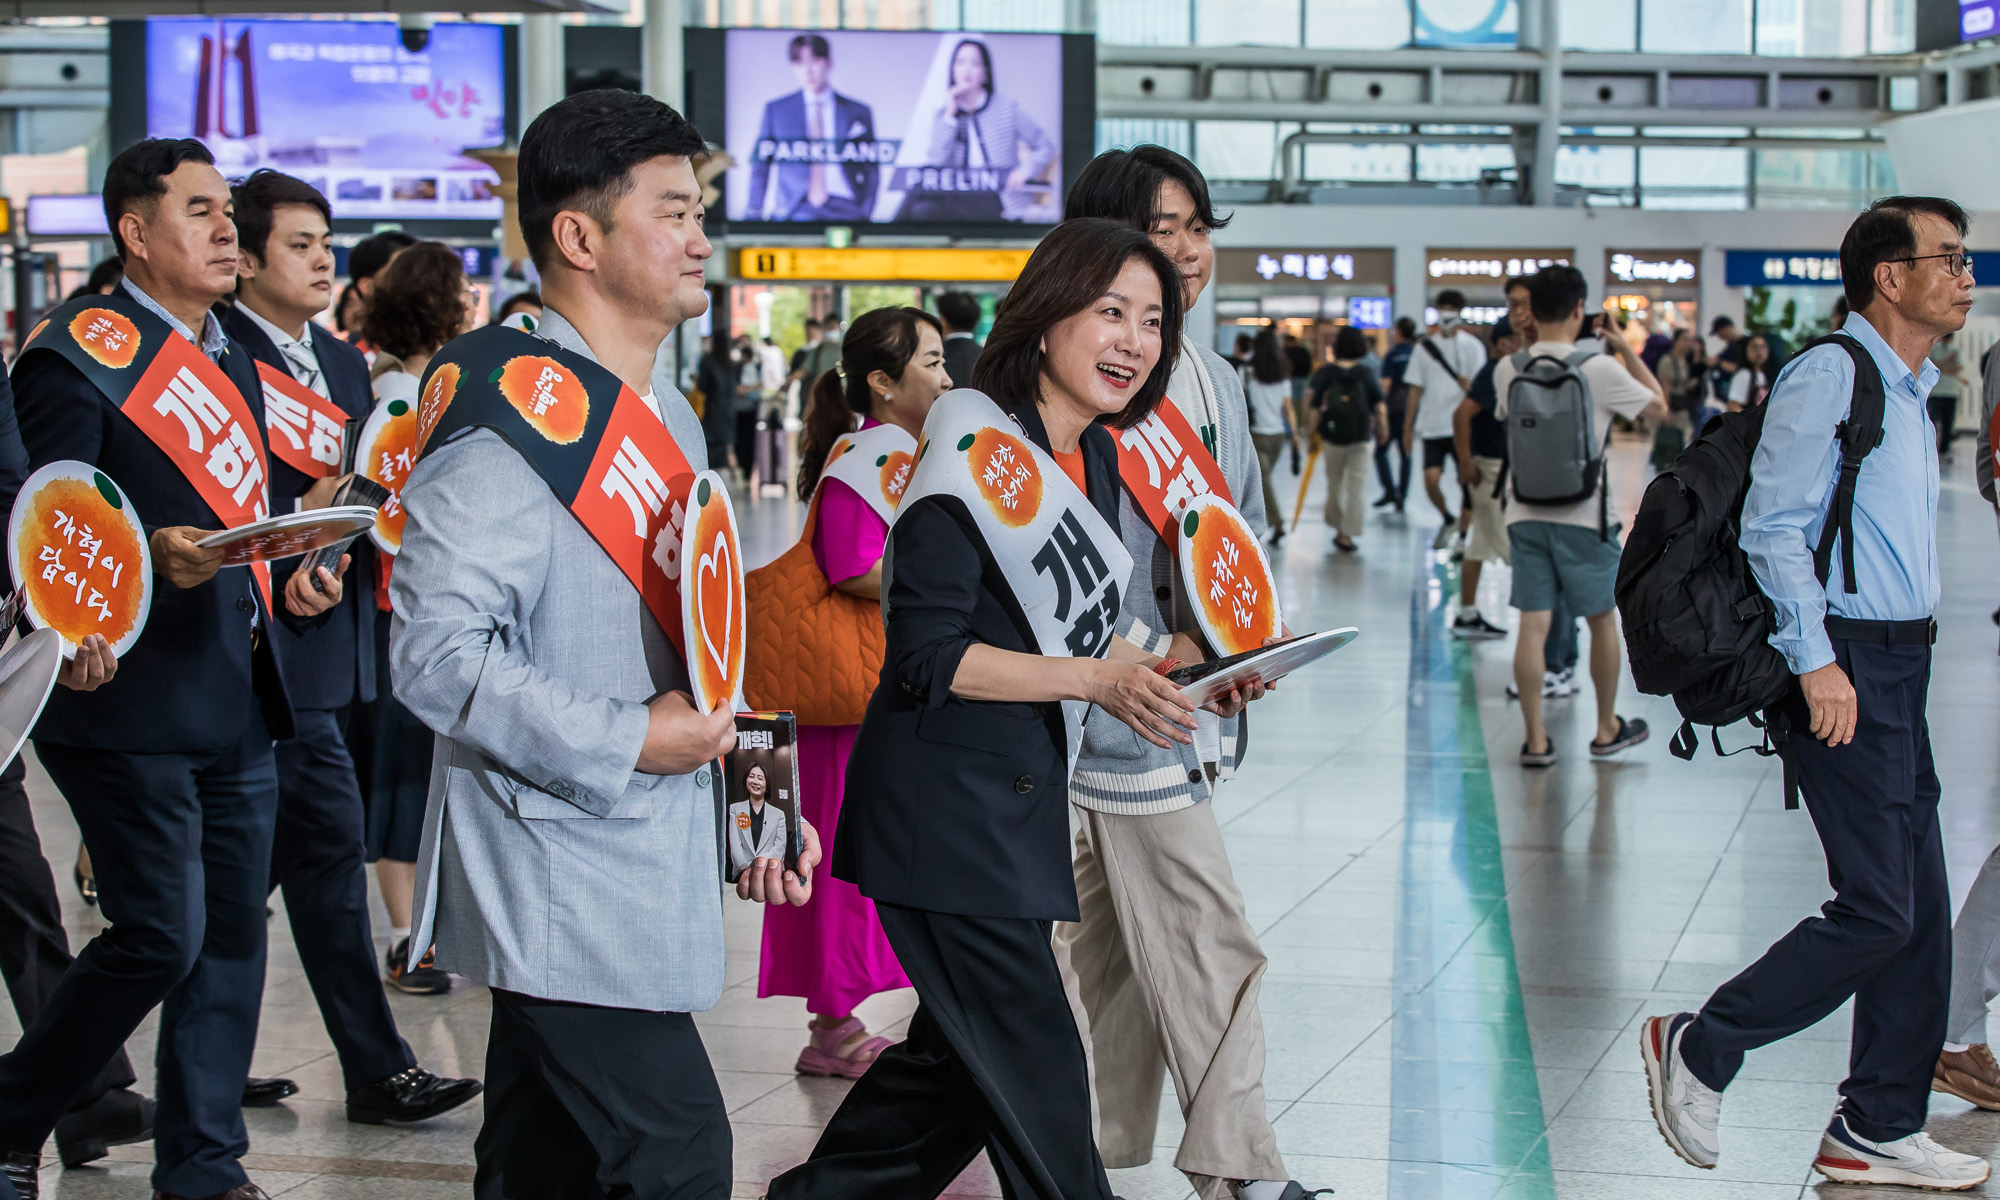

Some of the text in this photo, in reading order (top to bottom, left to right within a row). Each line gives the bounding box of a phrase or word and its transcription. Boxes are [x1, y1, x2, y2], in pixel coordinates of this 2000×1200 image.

[758, 139, 897, 163] PARKLAND
[533, 366, 563, 417] 개혁신당
[53, 509, 123, 589] 개혁이
[1210, 536, 1240, 608] 개혁은
[38, 544, 113, 622] 답이다
[1232, 575, 1258, 629] 실천
[736, 730, 774, 750] 개혁!
